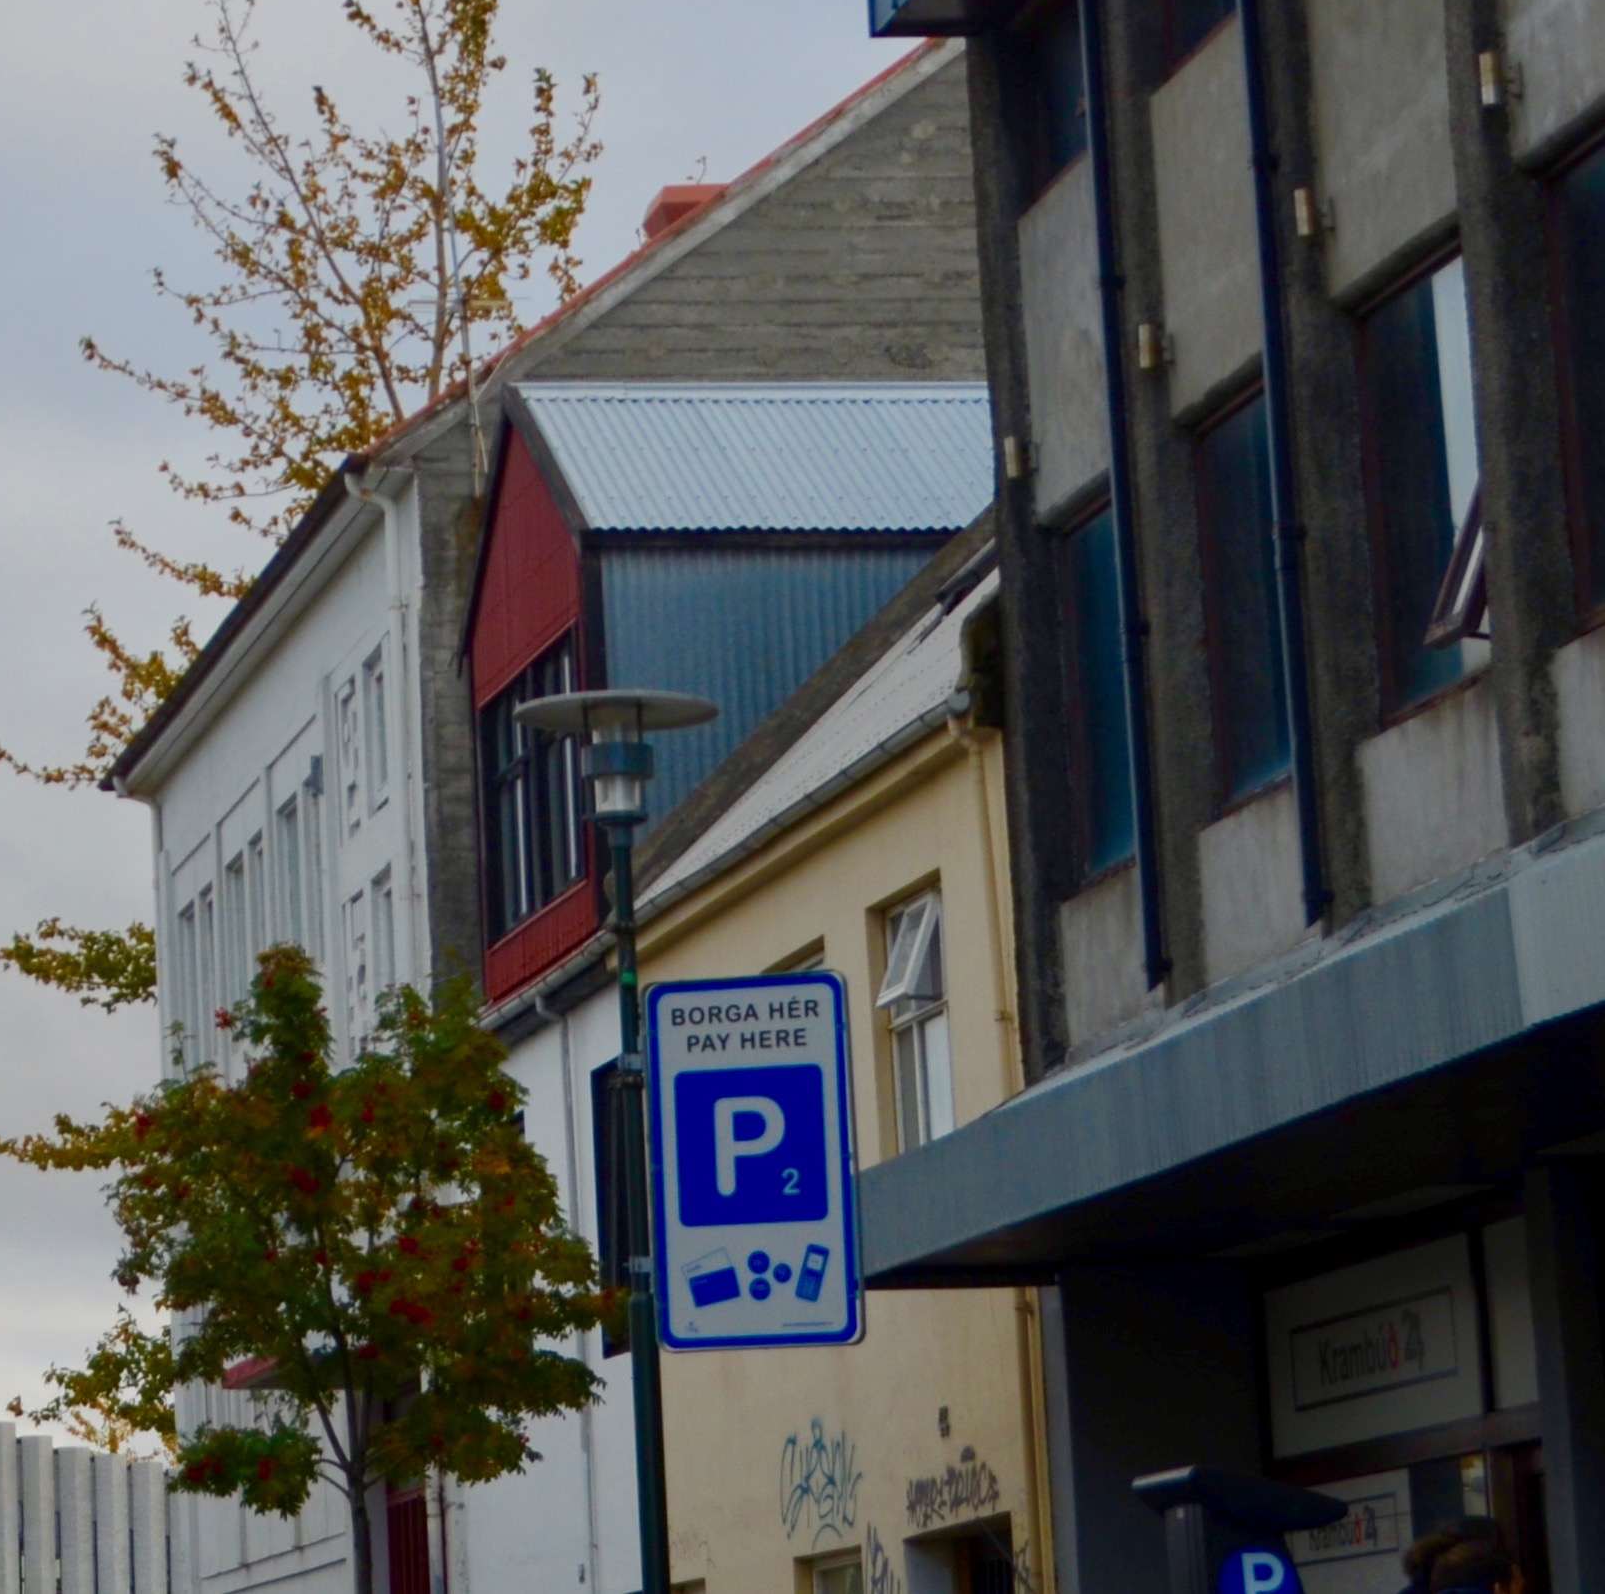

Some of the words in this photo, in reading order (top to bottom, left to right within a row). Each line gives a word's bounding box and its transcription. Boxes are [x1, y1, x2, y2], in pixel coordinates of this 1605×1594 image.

[671, 1003, 758, 1026] BORGA
[769, 996, 819, 1021] HÉR
[686, 1032, 731, 1053] PAY
[741, 1028, 807, 1050] HERE
[714, 1096, 786, 1197] P
[782, 1168, 801, 1195] 2
[1241, 1552, 1285, 1594] P
